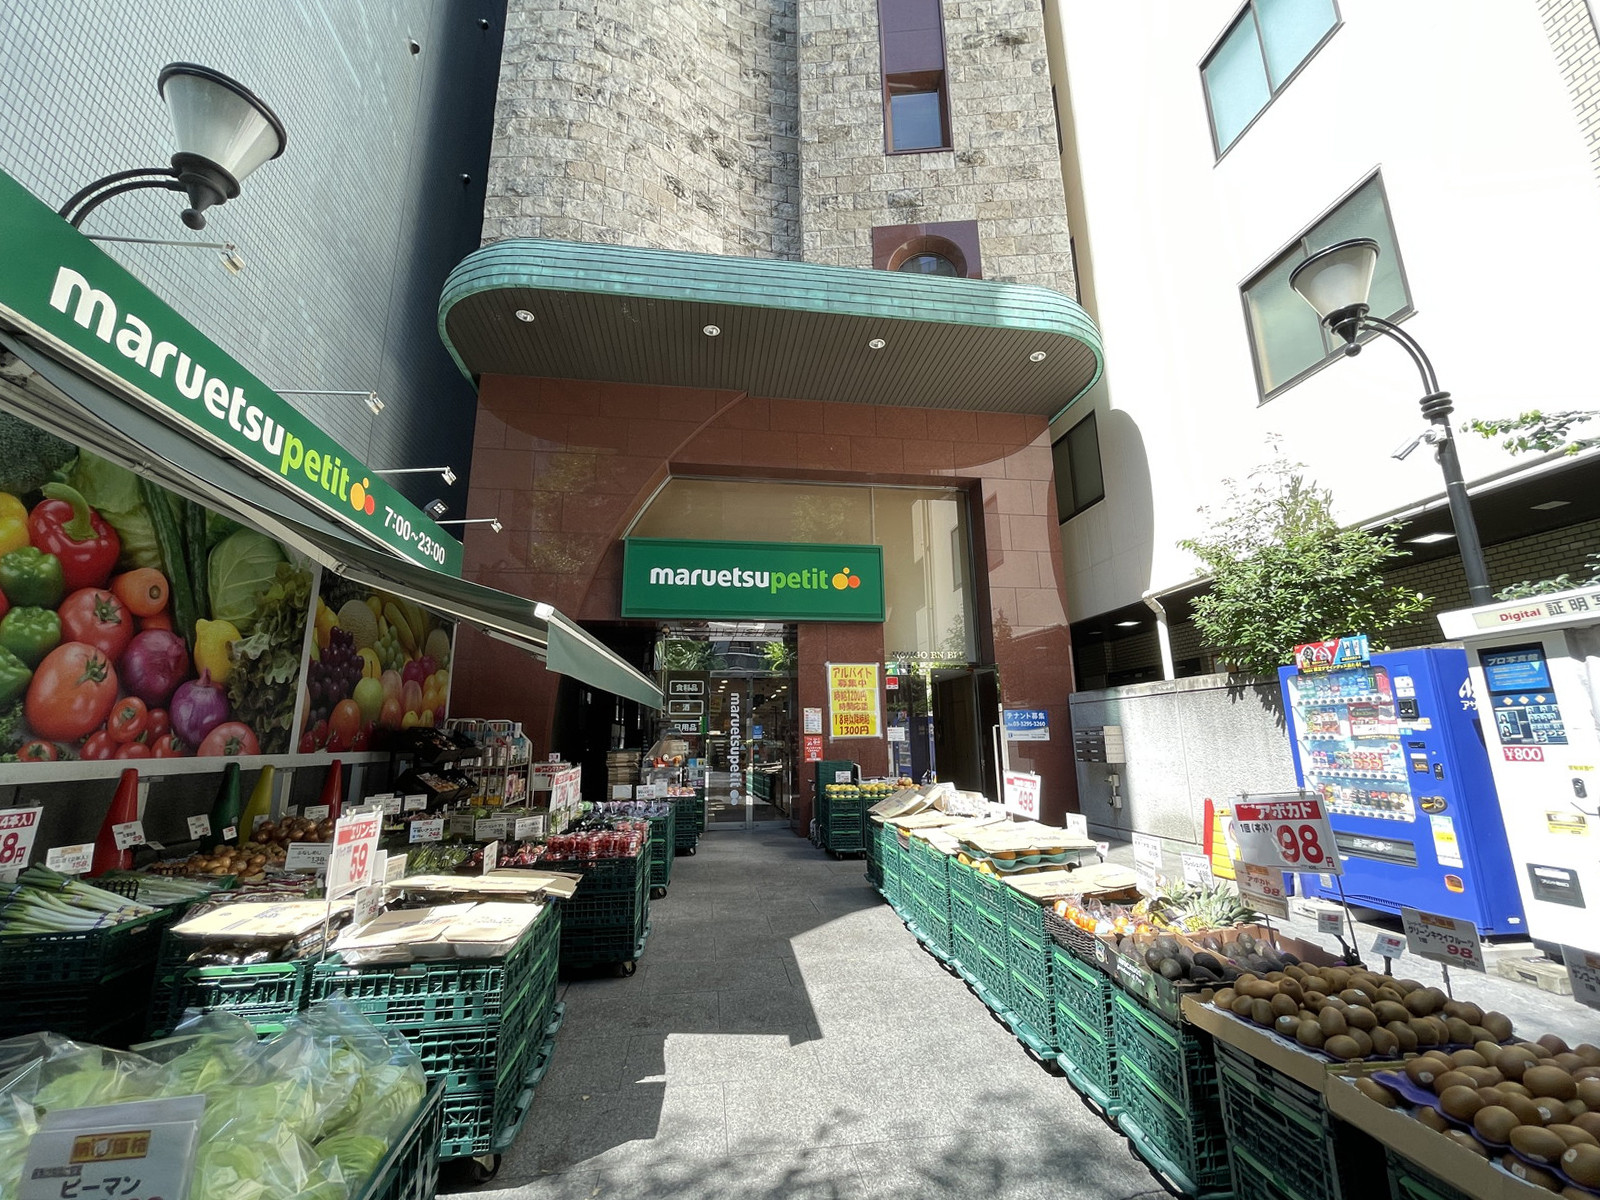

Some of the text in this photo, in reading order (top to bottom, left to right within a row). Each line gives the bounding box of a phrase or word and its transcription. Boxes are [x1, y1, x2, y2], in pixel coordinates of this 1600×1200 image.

[650, 567, 828, 594] maruetsupetit
[1500, 608, 1542, 622] Digital
[1487, 653, 1540, 666] プロ写真館
[832, 667, 872, 679] アルバイト
[675, 683, 699, 692] 食料品
[837, 679, 867, 688] 募集中
[682, 703, 691, 712] 酒
[1006, 712, 1045, 721] テナント募集
[839, 725, 870, 735] 1300円
[727, 692, 743, 788] maruetsupetit
[1503, 747, 1541, 761] ¥800
[1018, 790, 1033, 812] 498
[1255, 802, 1312, 819] アボカド
[1276, 824, 1324, 864] 98
[350, 842, 369, 883] 59
[1263, 886, 1280, 896] 98
[1408, 925, 1474, 948] グリーンキウイフルーツ
[1446, 943, 1473, 959] 98
